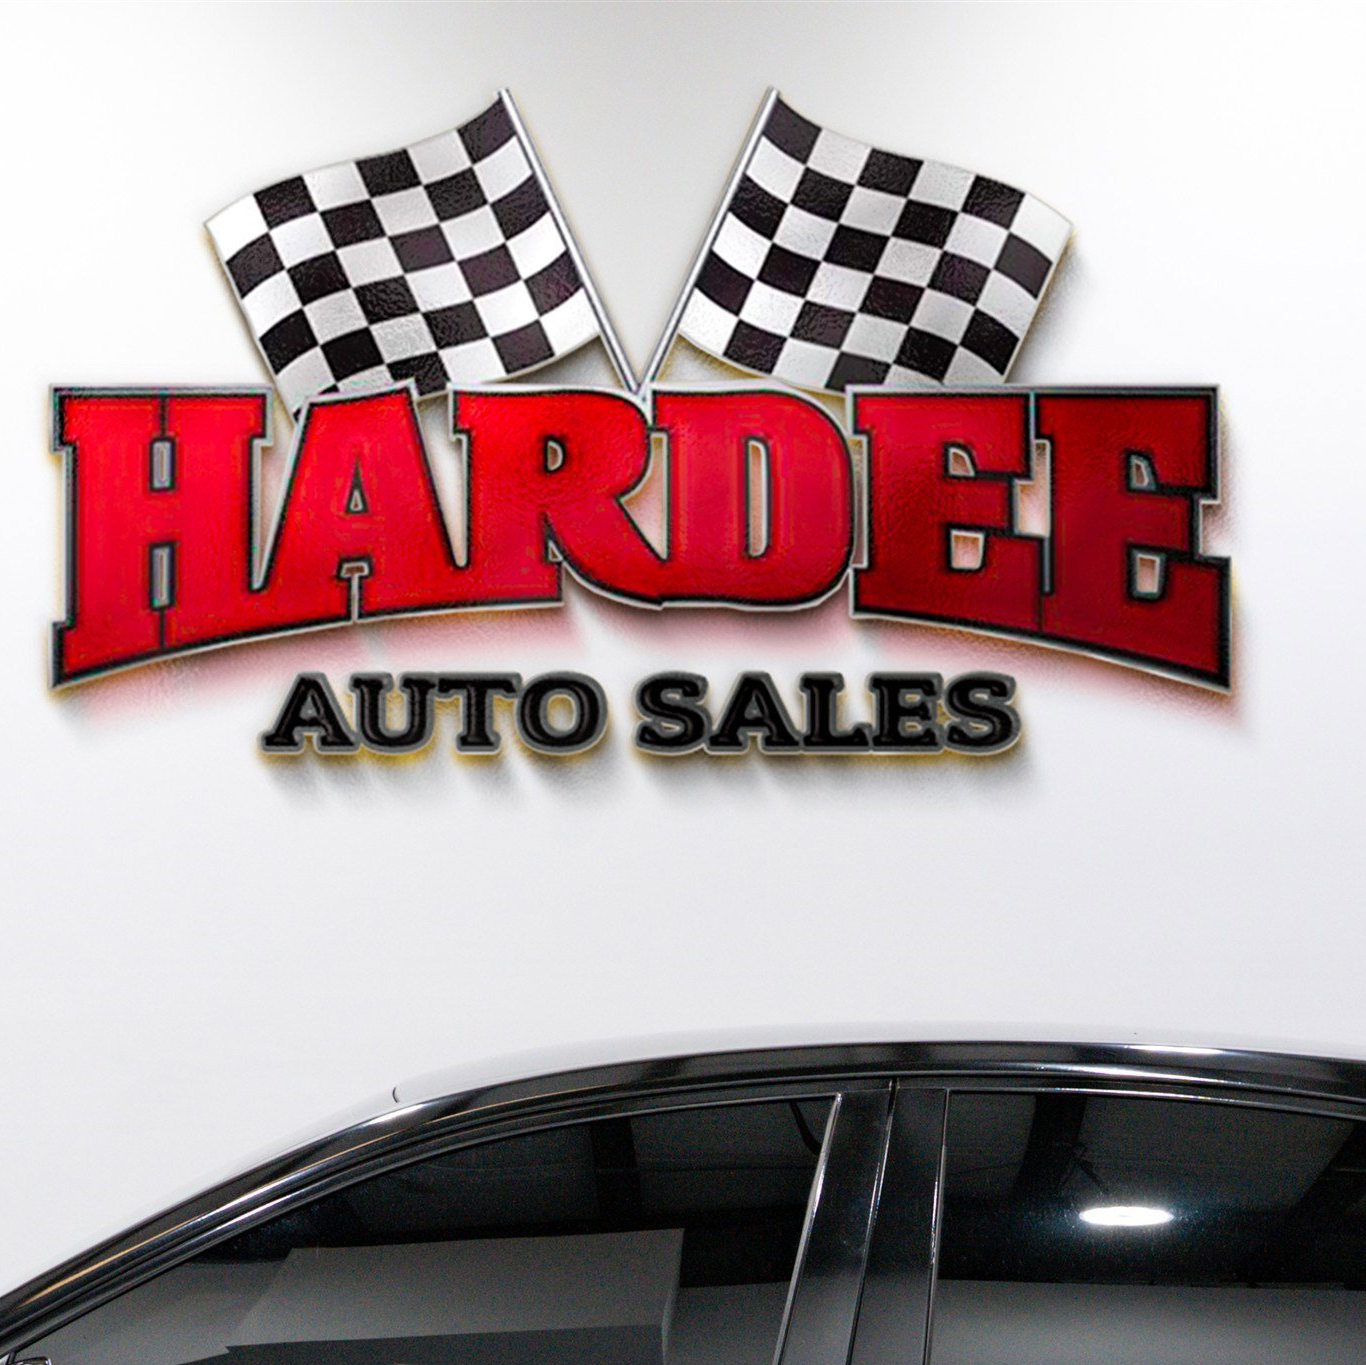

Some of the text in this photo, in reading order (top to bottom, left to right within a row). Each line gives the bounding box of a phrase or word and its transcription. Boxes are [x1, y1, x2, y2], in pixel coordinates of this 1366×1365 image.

[50, 380, 1232, 692] HARDEE
[260, 671, 1023, 755] AUTO SALES
